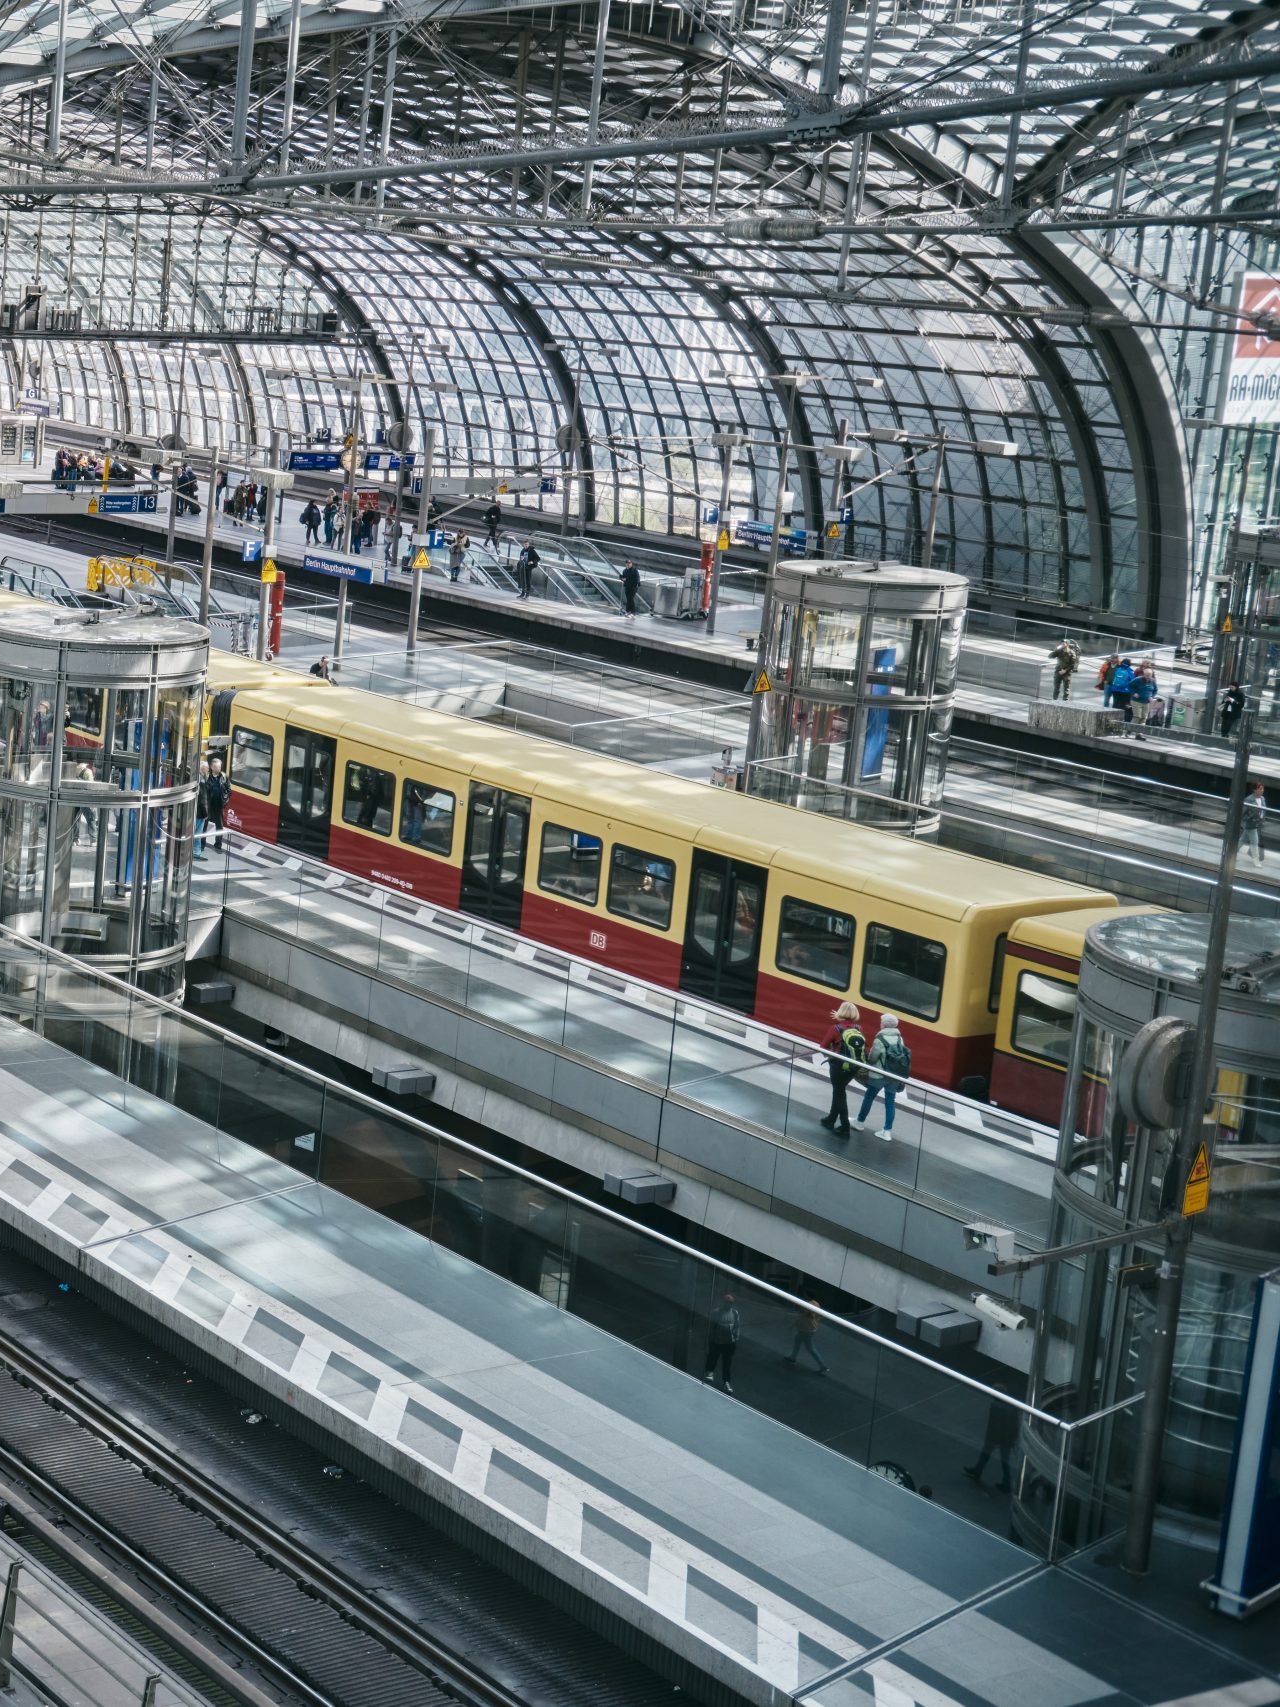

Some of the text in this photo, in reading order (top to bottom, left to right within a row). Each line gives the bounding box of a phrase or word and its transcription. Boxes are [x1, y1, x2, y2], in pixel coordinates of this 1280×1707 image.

[28, 389, 36, 398] G
[319, 429, 329, 439] 12
[143, 496, 155, 509] 13
[706, 508, 714, 521] F
[842, 509, 851, 521] F
[434, 531, 443, 545] F
[246, 541, 256, 557] F
[305, 558, 356, 576] Berlin Hauptbahnhof
[592, 933, 604, 947] DB
